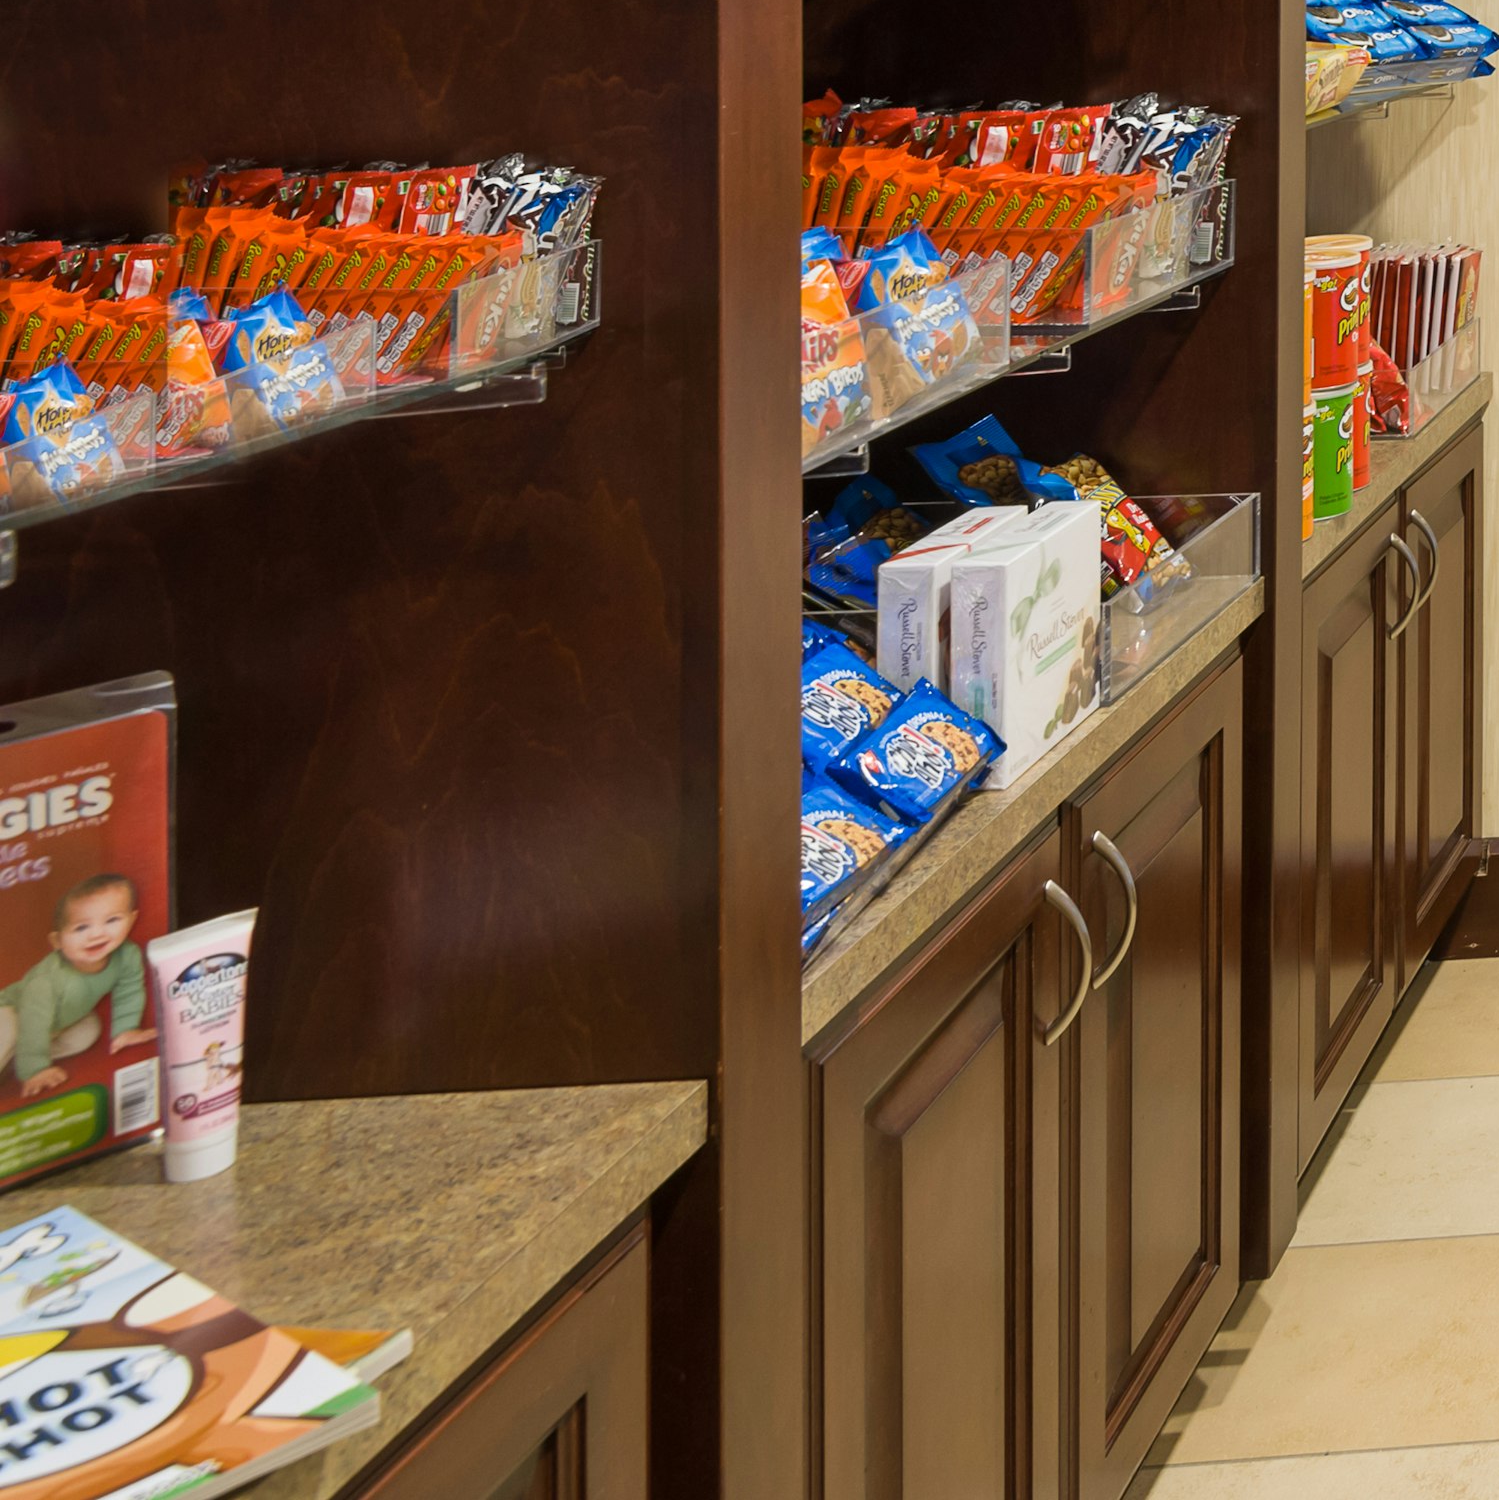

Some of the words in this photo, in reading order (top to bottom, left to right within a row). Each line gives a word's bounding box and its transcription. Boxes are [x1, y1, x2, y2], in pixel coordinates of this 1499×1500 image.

[897, 597, 918, 641] Russell
[968, 596, 988, 639] Russell
[1026, 622, 1060, 660] Russell
[1059, 608, 1085, 639] Stover
[901, 640, 918, 678] Stover
[969, 637, 984, 676] Stover
[0, 1380, 154, 1466] HOT
